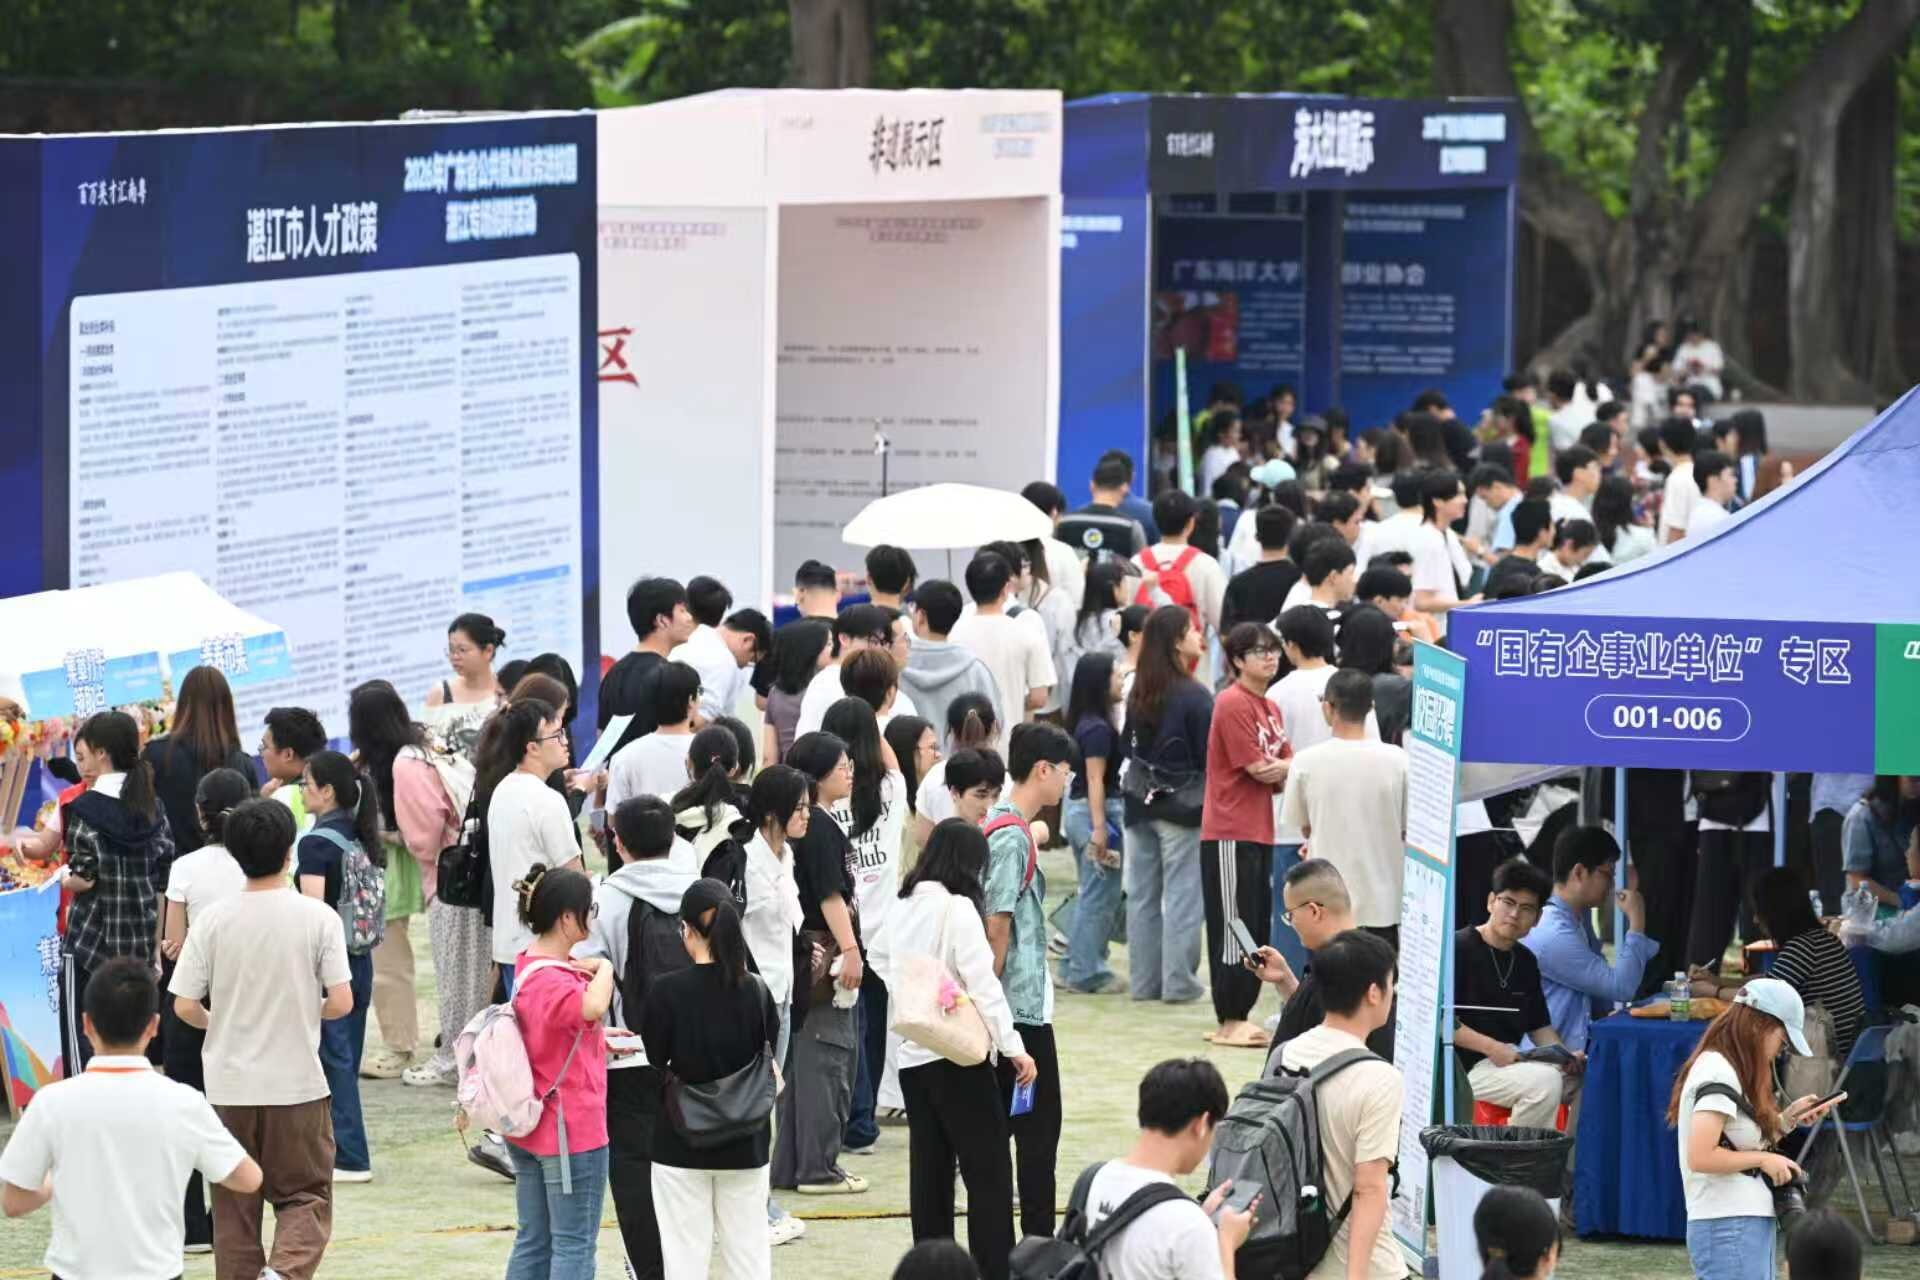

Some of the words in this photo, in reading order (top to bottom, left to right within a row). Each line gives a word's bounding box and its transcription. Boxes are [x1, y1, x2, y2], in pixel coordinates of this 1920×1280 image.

[246, 201, 379, 263] 湛江市人才政策
[1612, 705, 1723, 732] 001-006
